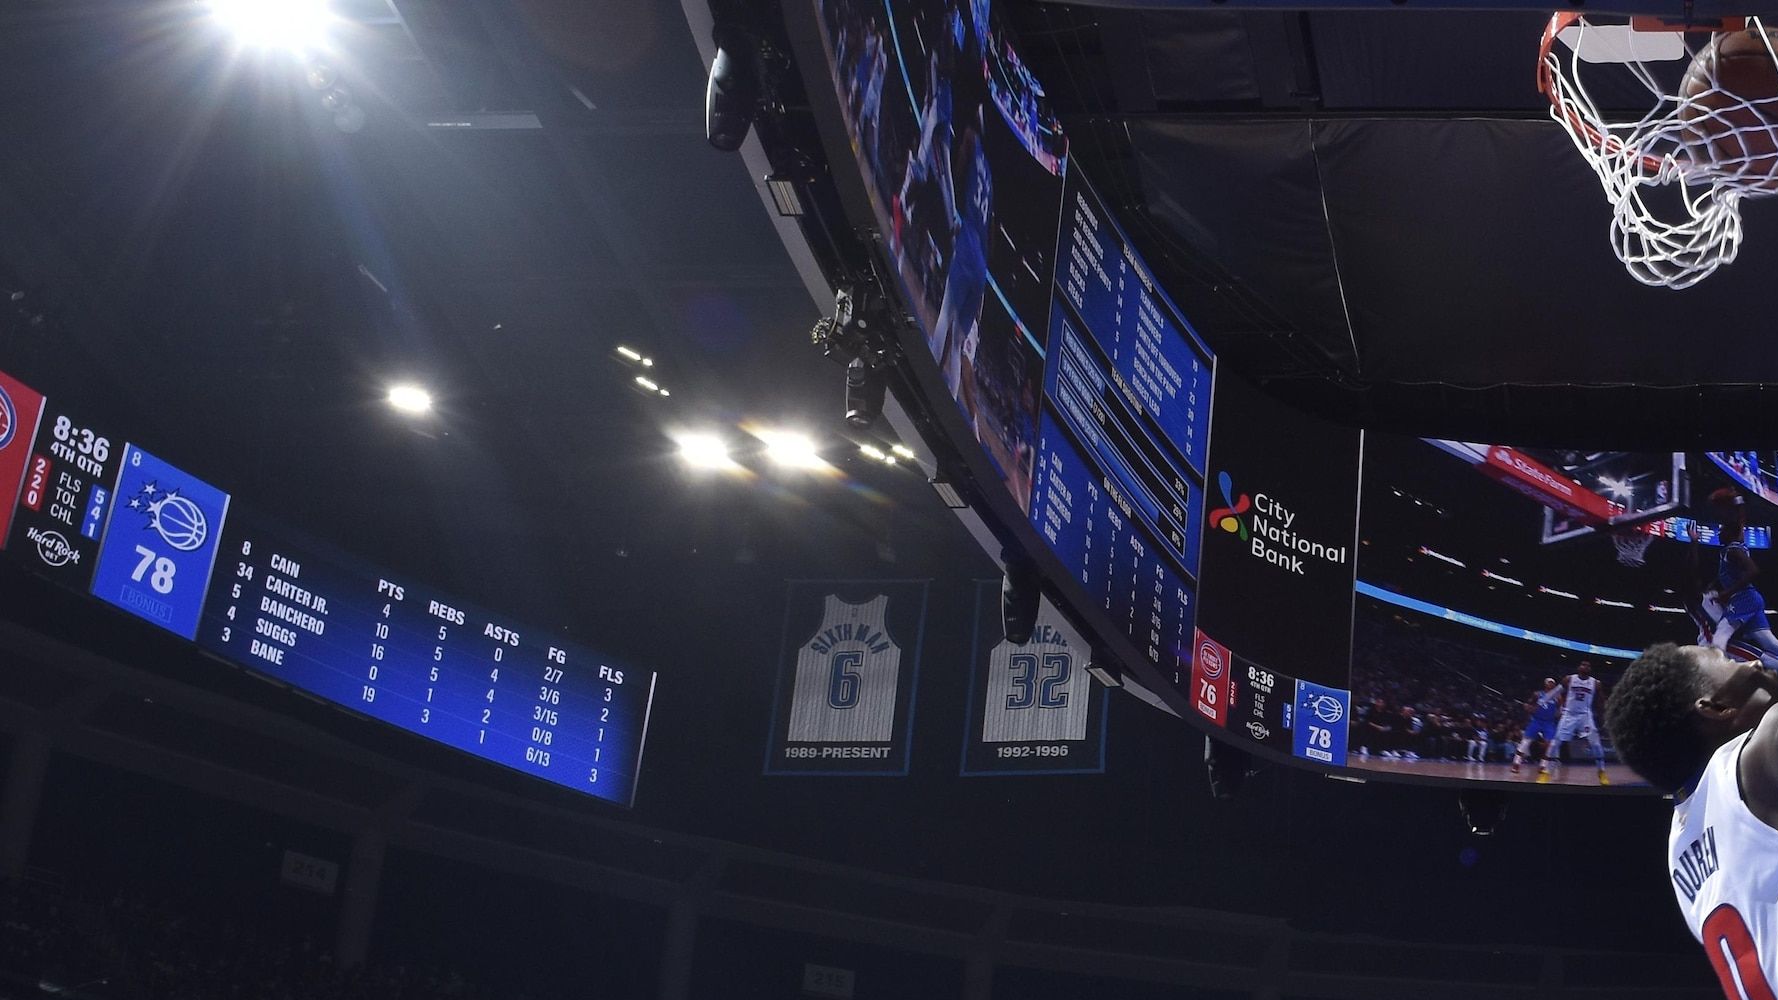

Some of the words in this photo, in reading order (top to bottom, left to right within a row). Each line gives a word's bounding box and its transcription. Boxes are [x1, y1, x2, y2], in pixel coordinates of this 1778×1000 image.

[54, 415, 109, 462] 8:36
[50, 442, 74, 463] 4TH
[77, 455, 103, 478] QTR
[56, 487, 77, 509] TOL
[59, 472, 82, 492] FLS
[50, 504, 73, 526] CHL
[1254, 493, 1295, 528] City
[26, 527, 55, 549] Hard
[53, 542, 81, 565] Rock
[1252, 537, 1305, 575] Bank
[1253, 515, 1346, 564] National
[132, 545, 176, 593] 78
[237, 562, 253, 580] 34
[266, 575, 311, 606] CARTER
[311, 595, 329, 615] JR.
[376, 623, 388, 639] 10
[540, 687, 559, 704] 3/6
[271, 554, 300, 578] CAIN
[544, 667, 563, 683] 2/7
[378, 579, 404, 600] PTS
[429, 601, 465, 625] REBS
[484, 623, 519, 646] ASTS
[548, 647, 565, 664] FG
[599, 666, 623, 684] FLS
[810, 623, 853, 655] SIXTH
[856, 624, 890, 655] MAN
[260, 596, 325, 636] BANCHERO
[372, 644, 384, 660] 16
[534, 706, 557, 725] 3/15
[1248, 666, 1274, 687] 8:36
[256, 618, 296, 646] SUGGS
[532, 727, 552, 745] 0/8
[827, 651, 864, 709] 6
[1006, 653, 1072, 710] 32
[1200, 678, 1217, 704] 76
[251, 640, 284, 665] BANE
[363, 686, 375, 702] 19
[526, 747, 550, 766] 6/13
[786, 747, 891, 758] 1989-PRESENT
[998, 745, 1068, 757] 1992-1996
[1309, 725, 1332, 749] 78
[1673, 826, 1719, 904] DUREN
